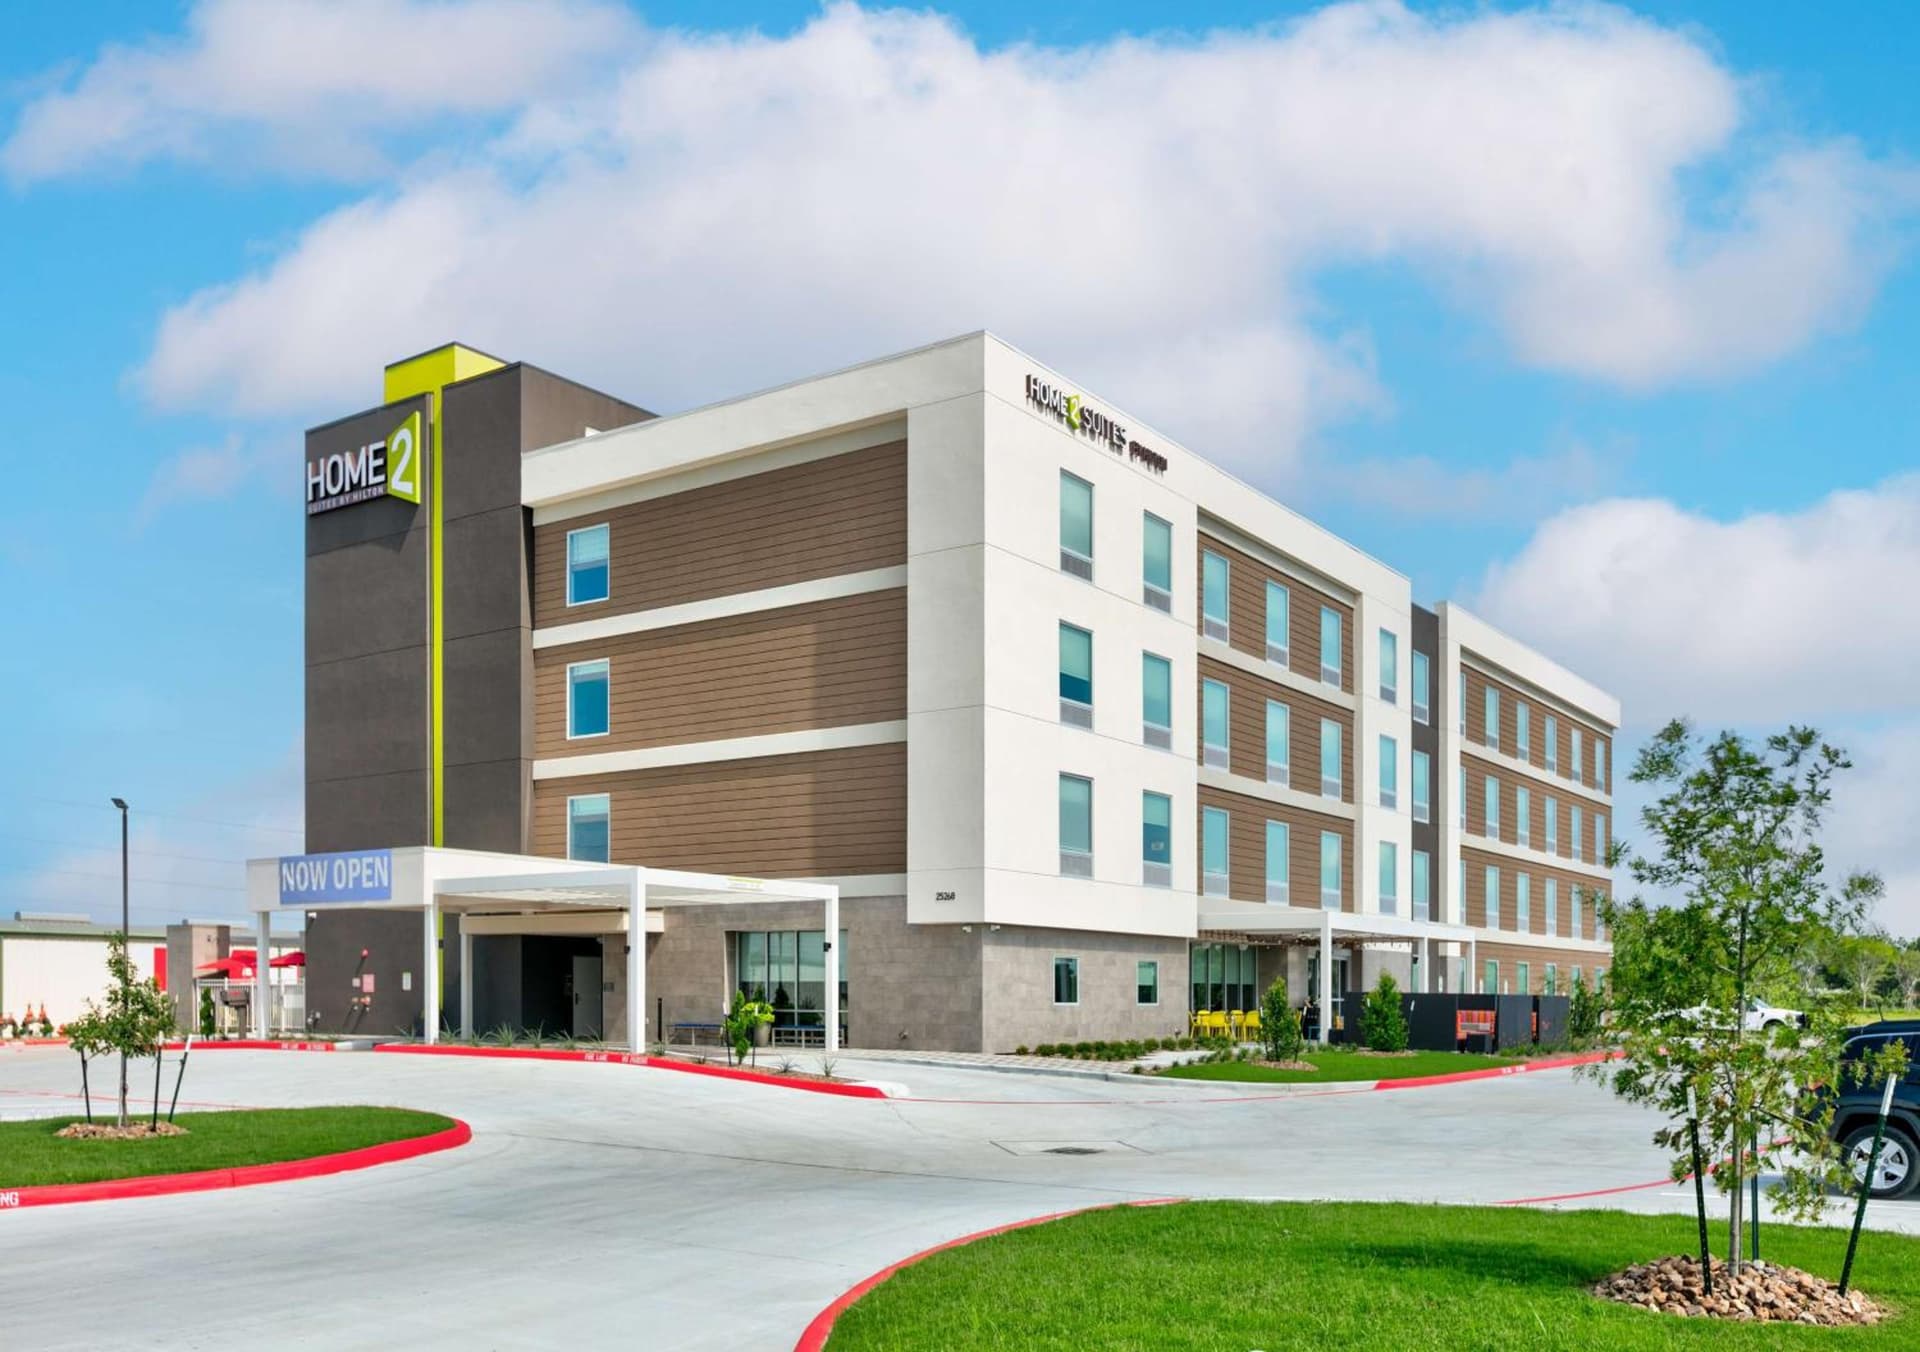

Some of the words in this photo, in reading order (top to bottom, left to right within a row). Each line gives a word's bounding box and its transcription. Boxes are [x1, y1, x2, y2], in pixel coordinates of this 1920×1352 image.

[1080, 406, 1127, 449] SUITES
[308, 440, 385, 500] HOME
[352, 487, 384, 501] HILTON
[282, 859, 328, 892] NOW
[333, 856, 388, 890] OPEN
